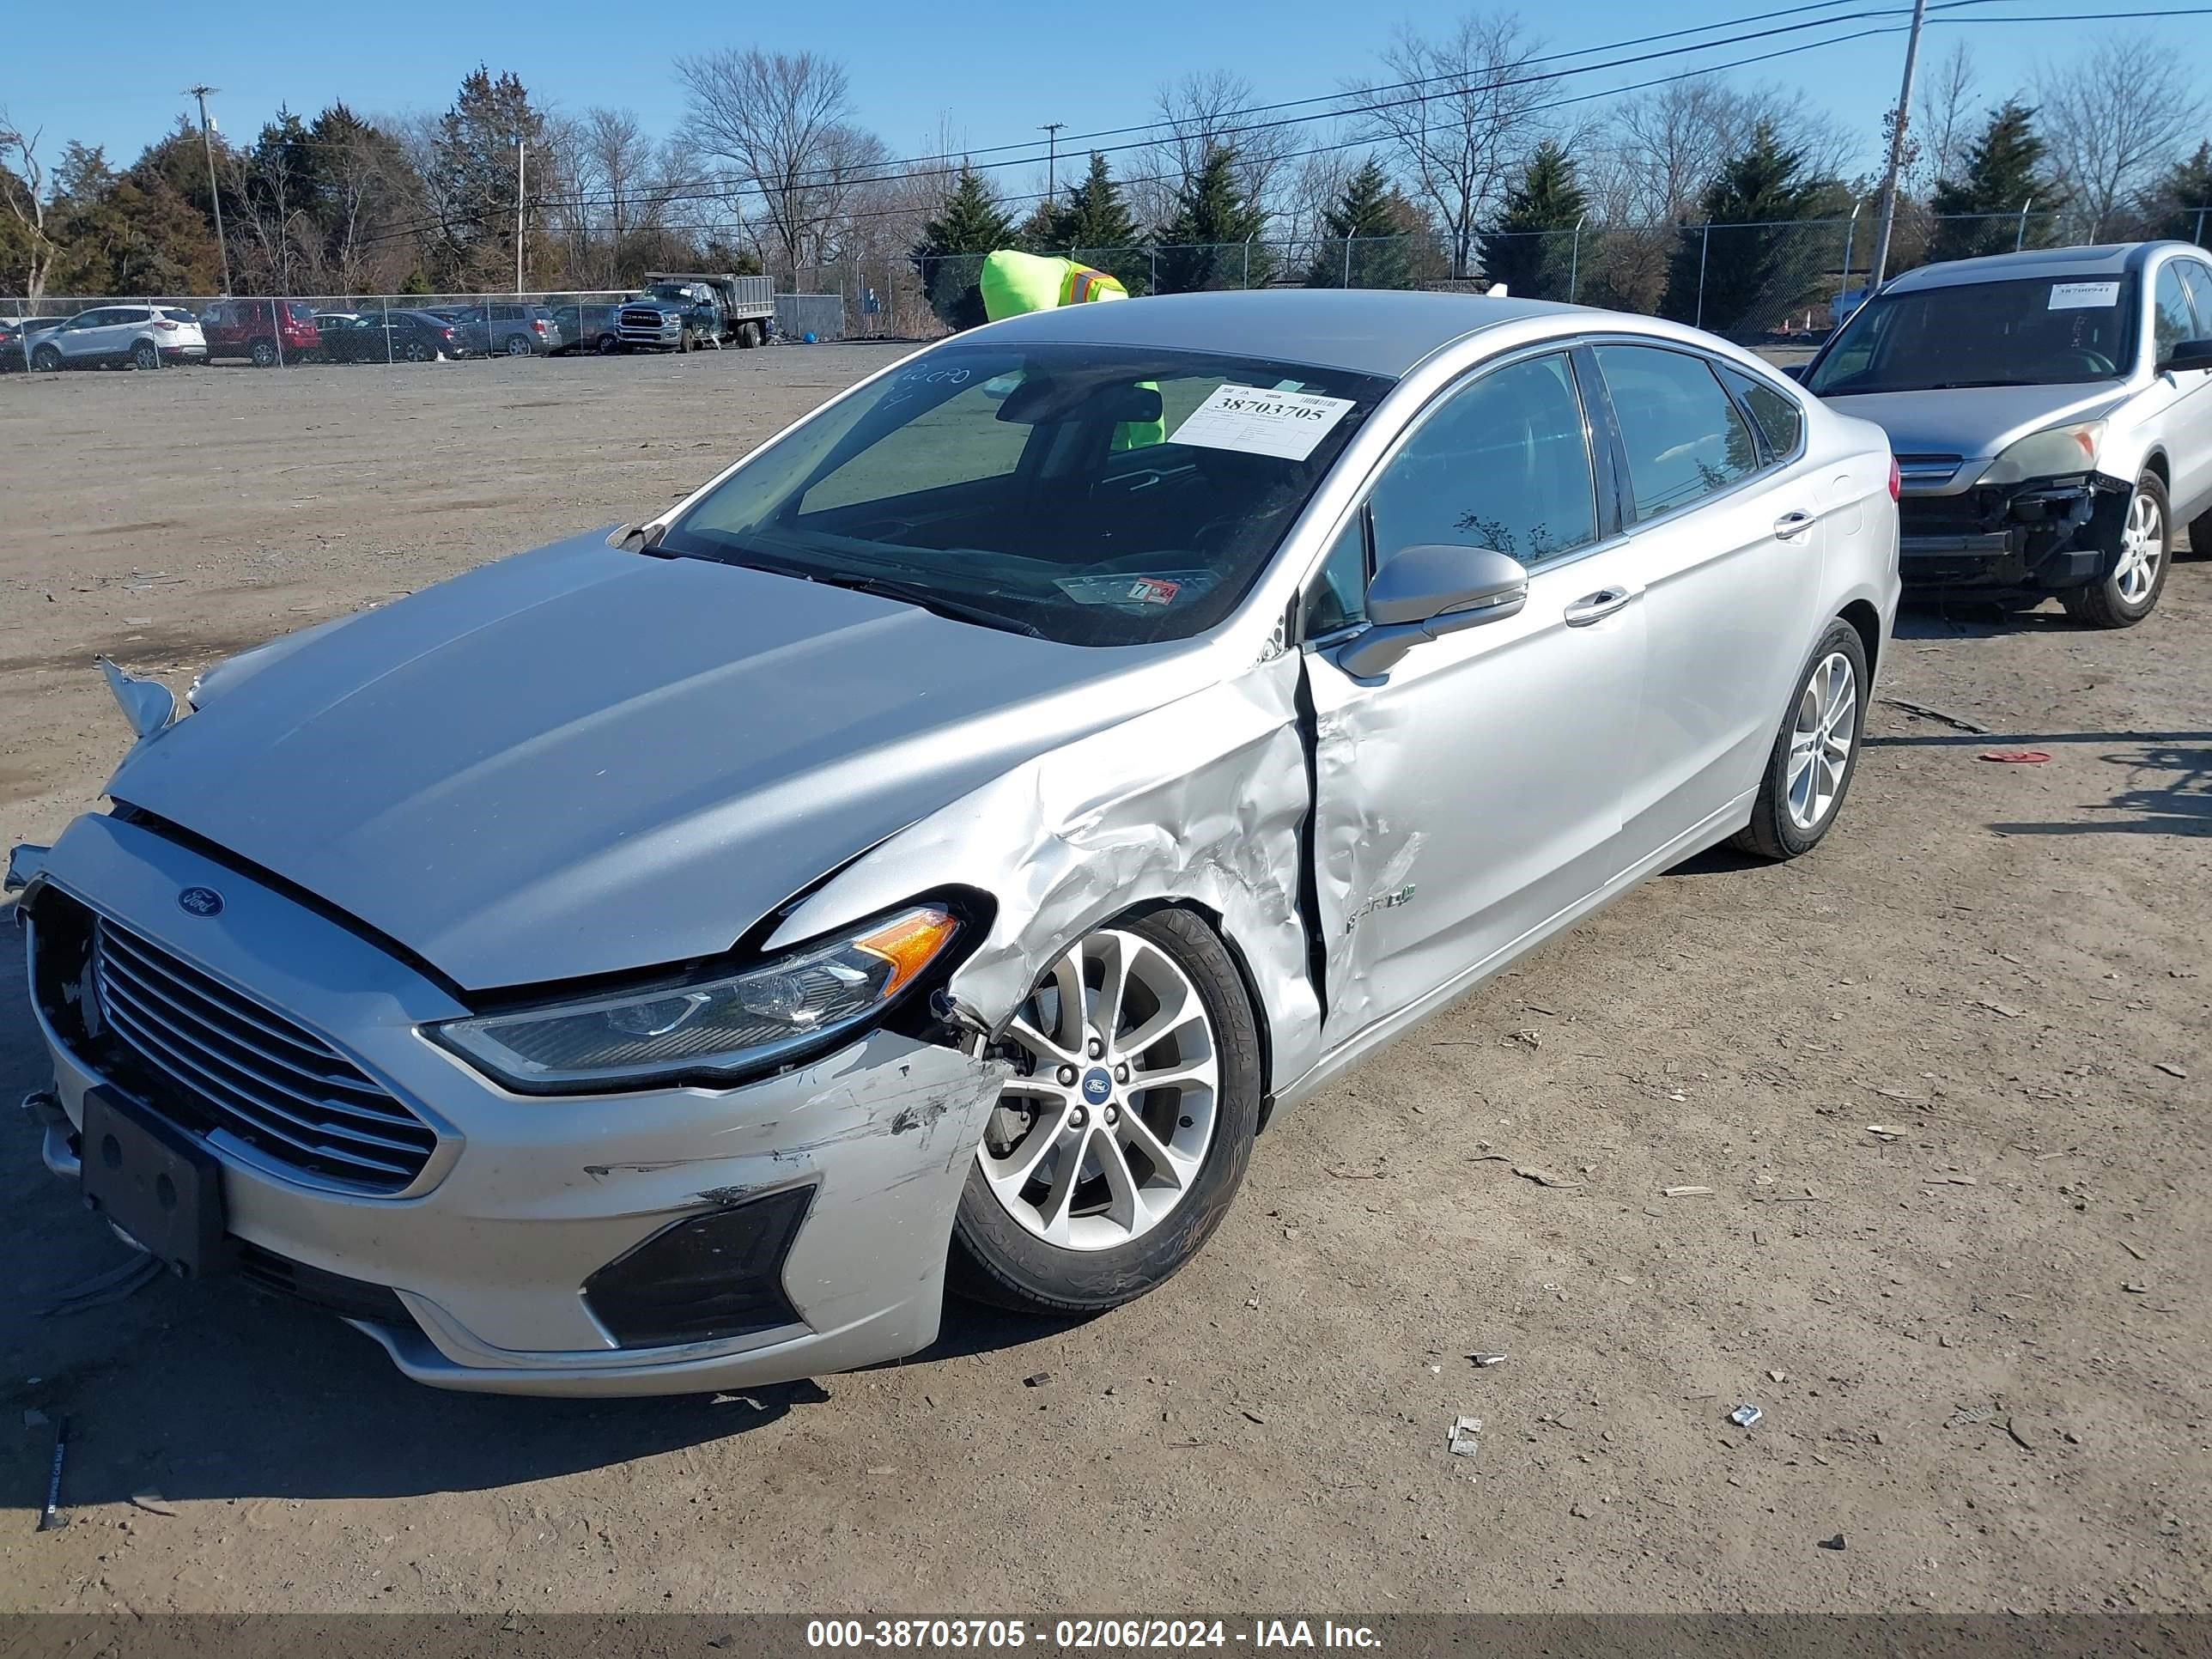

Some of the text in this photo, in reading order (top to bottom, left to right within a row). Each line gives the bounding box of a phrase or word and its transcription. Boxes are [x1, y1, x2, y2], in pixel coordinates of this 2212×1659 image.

[1214, 398, 1327, 421] 38703705
[1134, 583, 1147, 595] 7
[1161, 587, 1176, 599] 24
[183, 889, 215, 913] Ford
[1089, 1080, 1106, 1091] Ford
